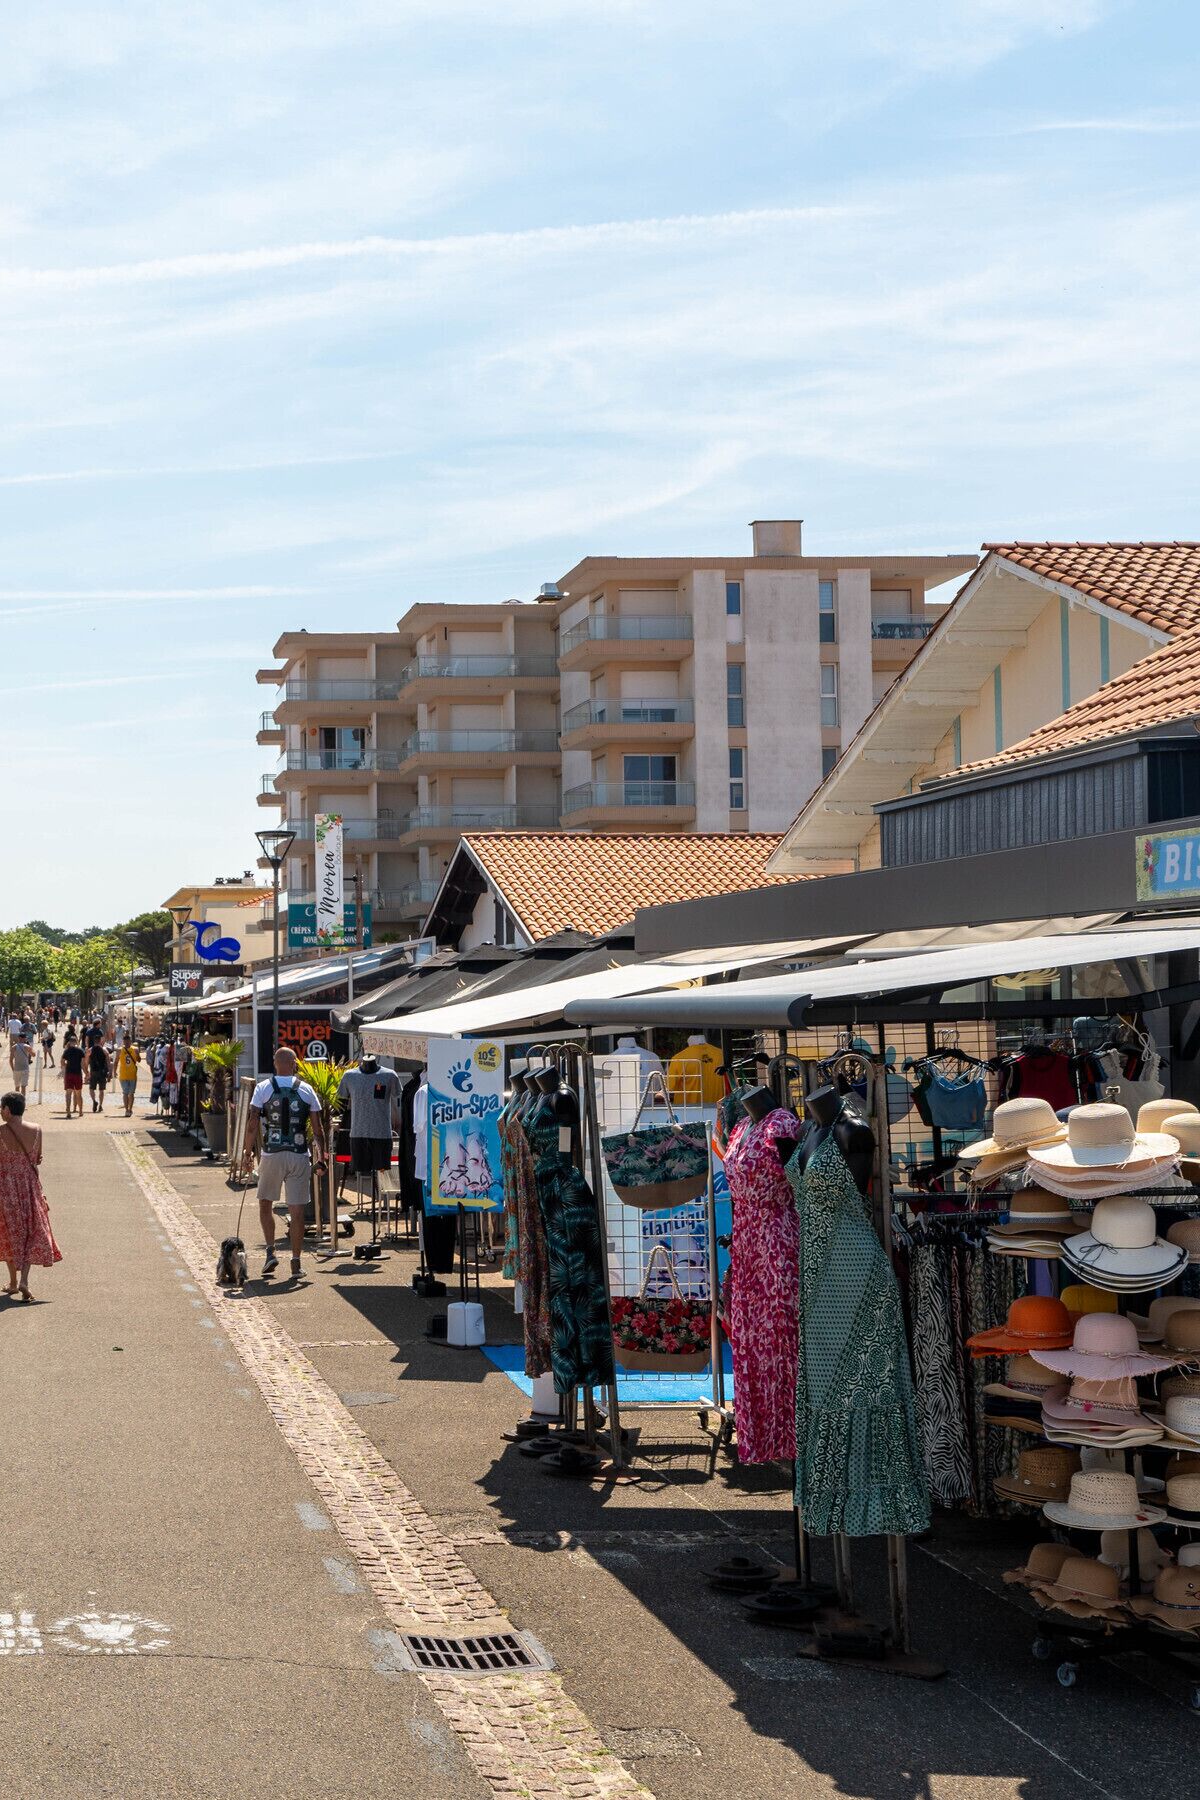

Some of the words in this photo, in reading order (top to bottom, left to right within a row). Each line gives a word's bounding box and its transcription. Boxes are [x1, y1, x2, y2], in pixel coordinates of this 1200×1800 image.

[1164, 841, 1200, 884] BI
[317, 850, 340, 915] Moorea
[171, 970, 202, 981] Super
[431, 1093, 499, 1126] Fish-Spa
[642, 1210, 708, 1239] tlantiqu
